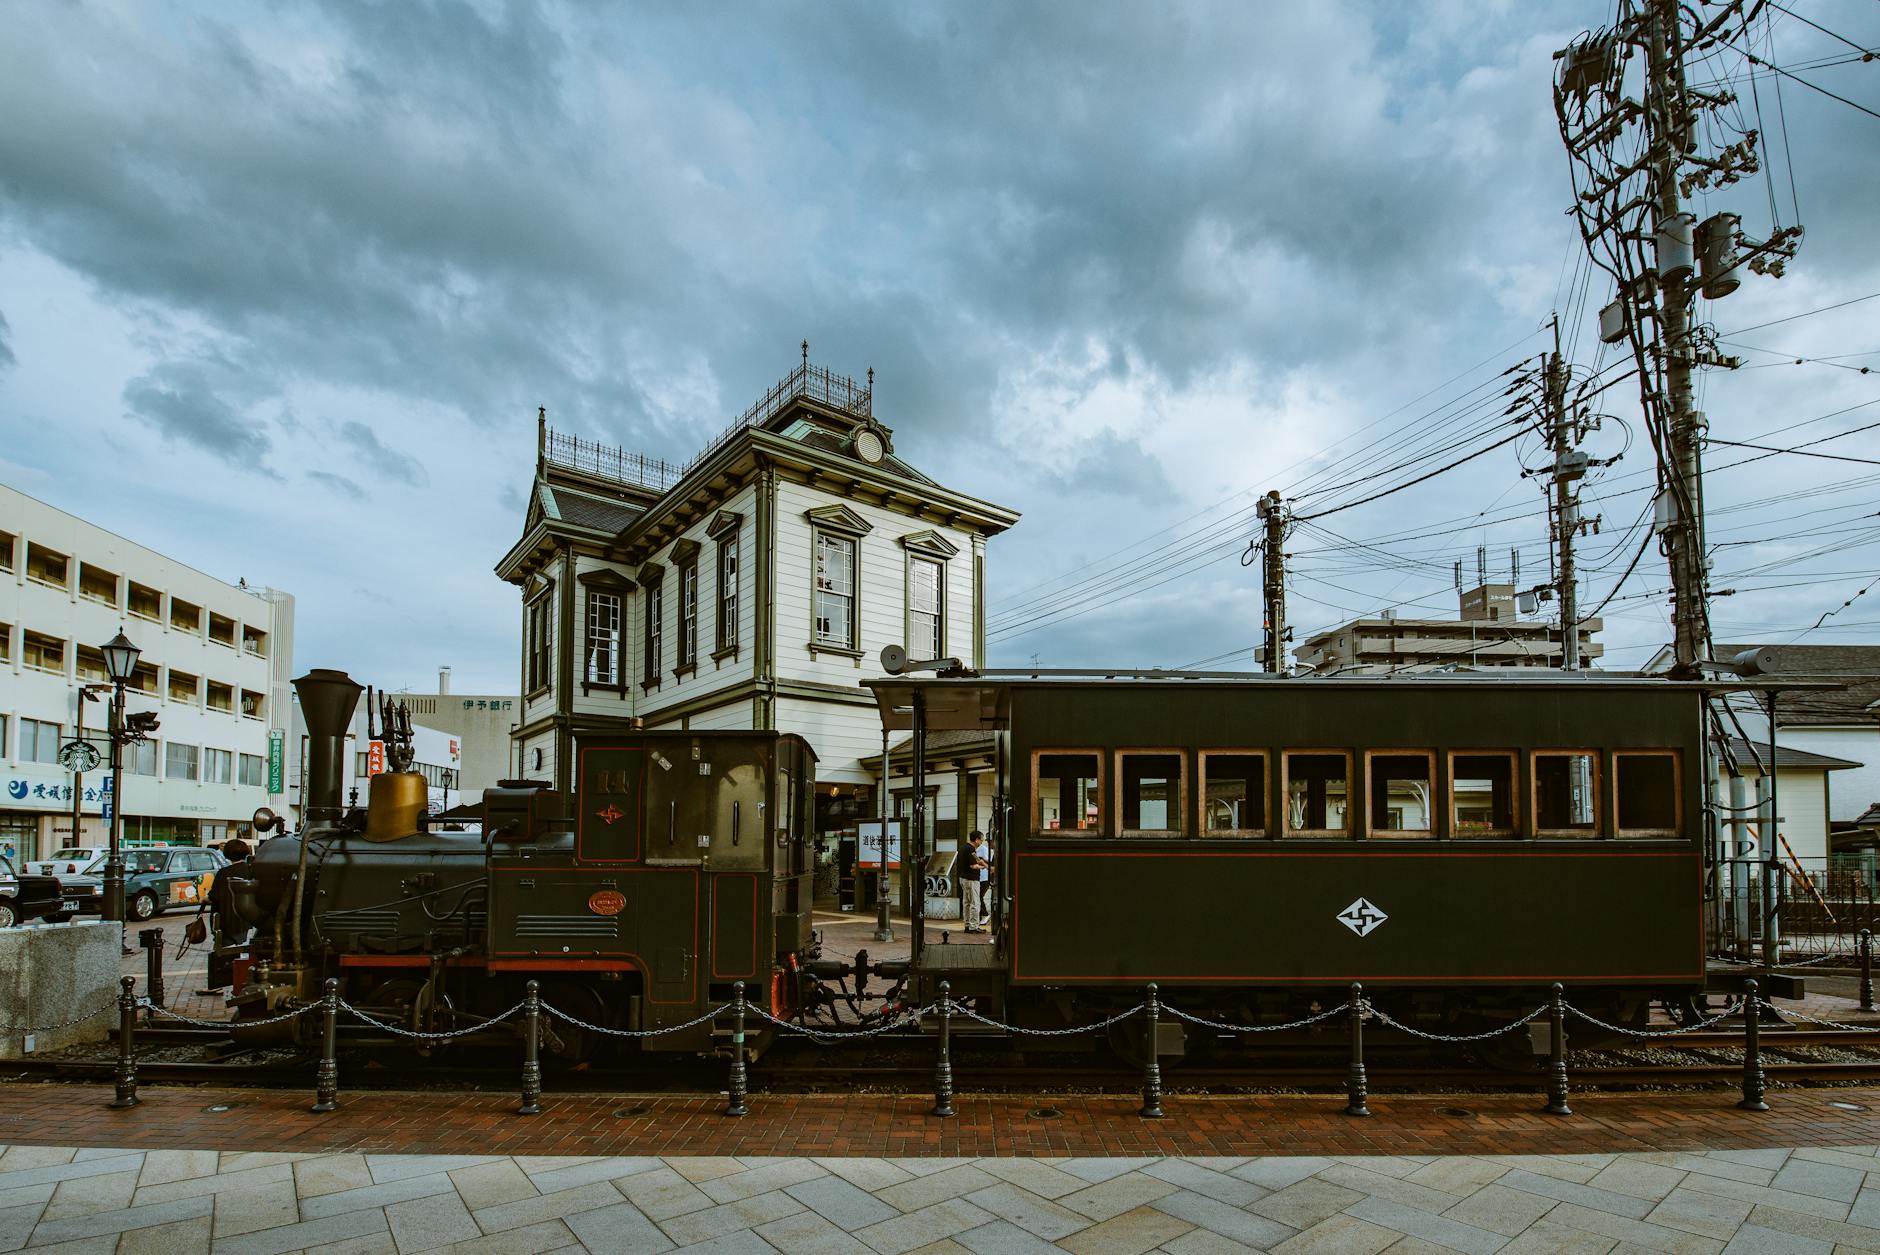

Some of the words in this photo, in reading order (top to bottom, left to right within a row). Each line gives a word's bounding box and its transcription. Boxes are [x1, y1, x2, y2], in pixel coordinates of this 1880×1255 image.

[464, 700, 512, 710] 伊予銀行
[33, 783, 103, 802] 愛媛信金
[863, 835, 896, 846] 道後温駅
